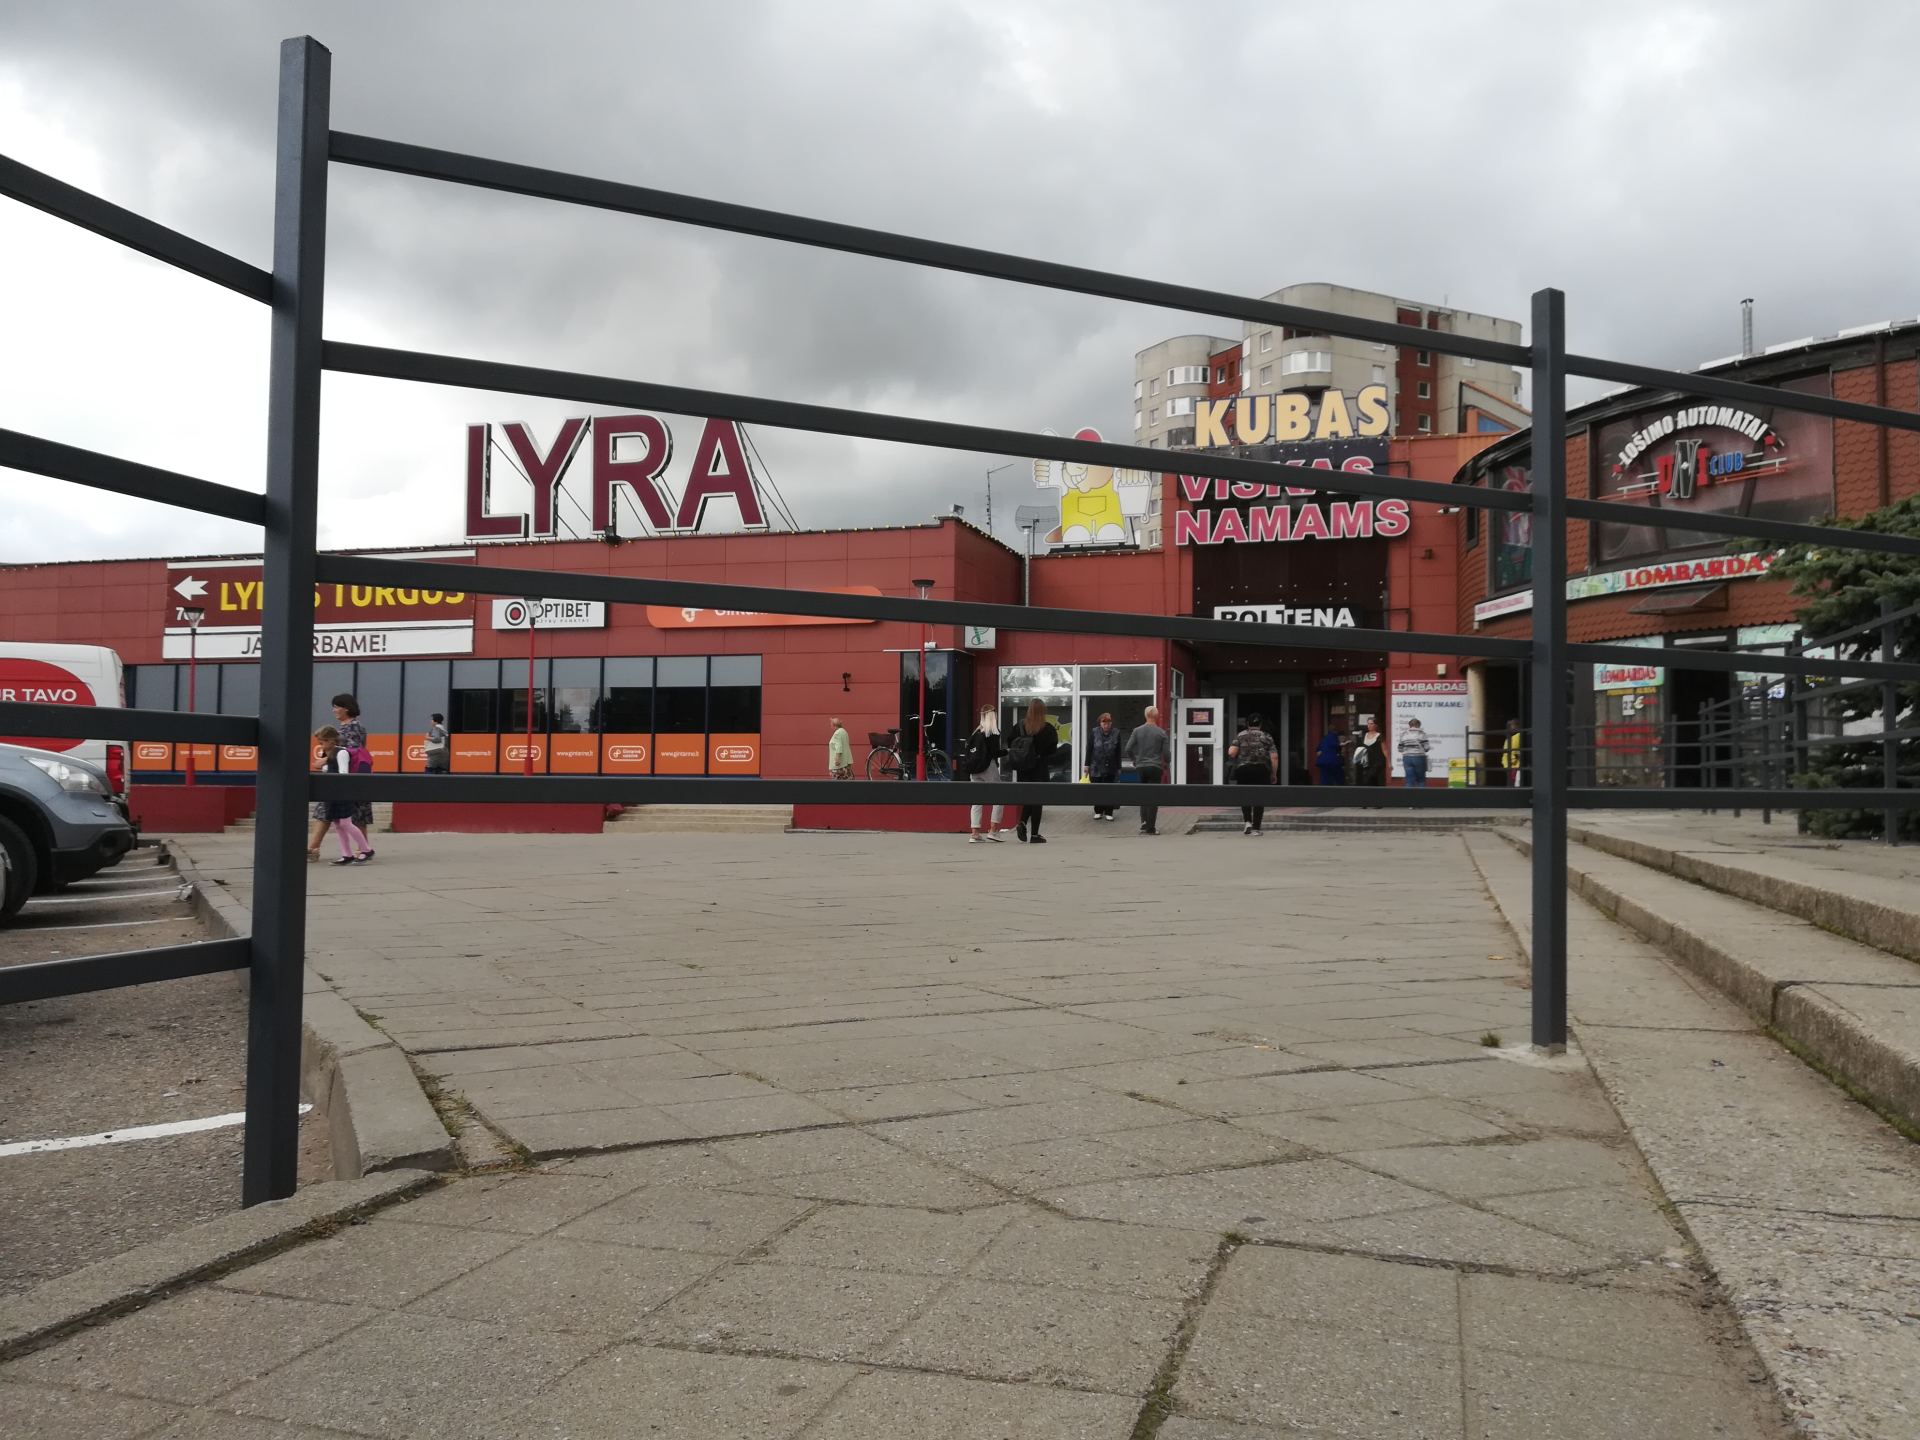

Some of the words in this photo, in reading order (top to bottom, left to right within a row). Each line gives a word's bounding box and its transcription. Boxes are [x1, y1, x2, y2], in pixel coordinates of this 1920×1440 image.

[1195, 385, 1390, 448] KUBAS
[1618, 415, 1675, 467] LOŠIMO
[1676, 405, 1769, 442] AUTOMATAI
[465, 414, 770, 539] LYRA
[1709, 452, 1744, 476] CLUB
[1175, 499, 1411, 546] NAMAMS
[241, 636, 262, 654] JA
[313, 634, 387, 654] RBAME!
[21, 688, 78, 702] TAVO
[1392, 682, 1468, 692] LOMBARDAS
